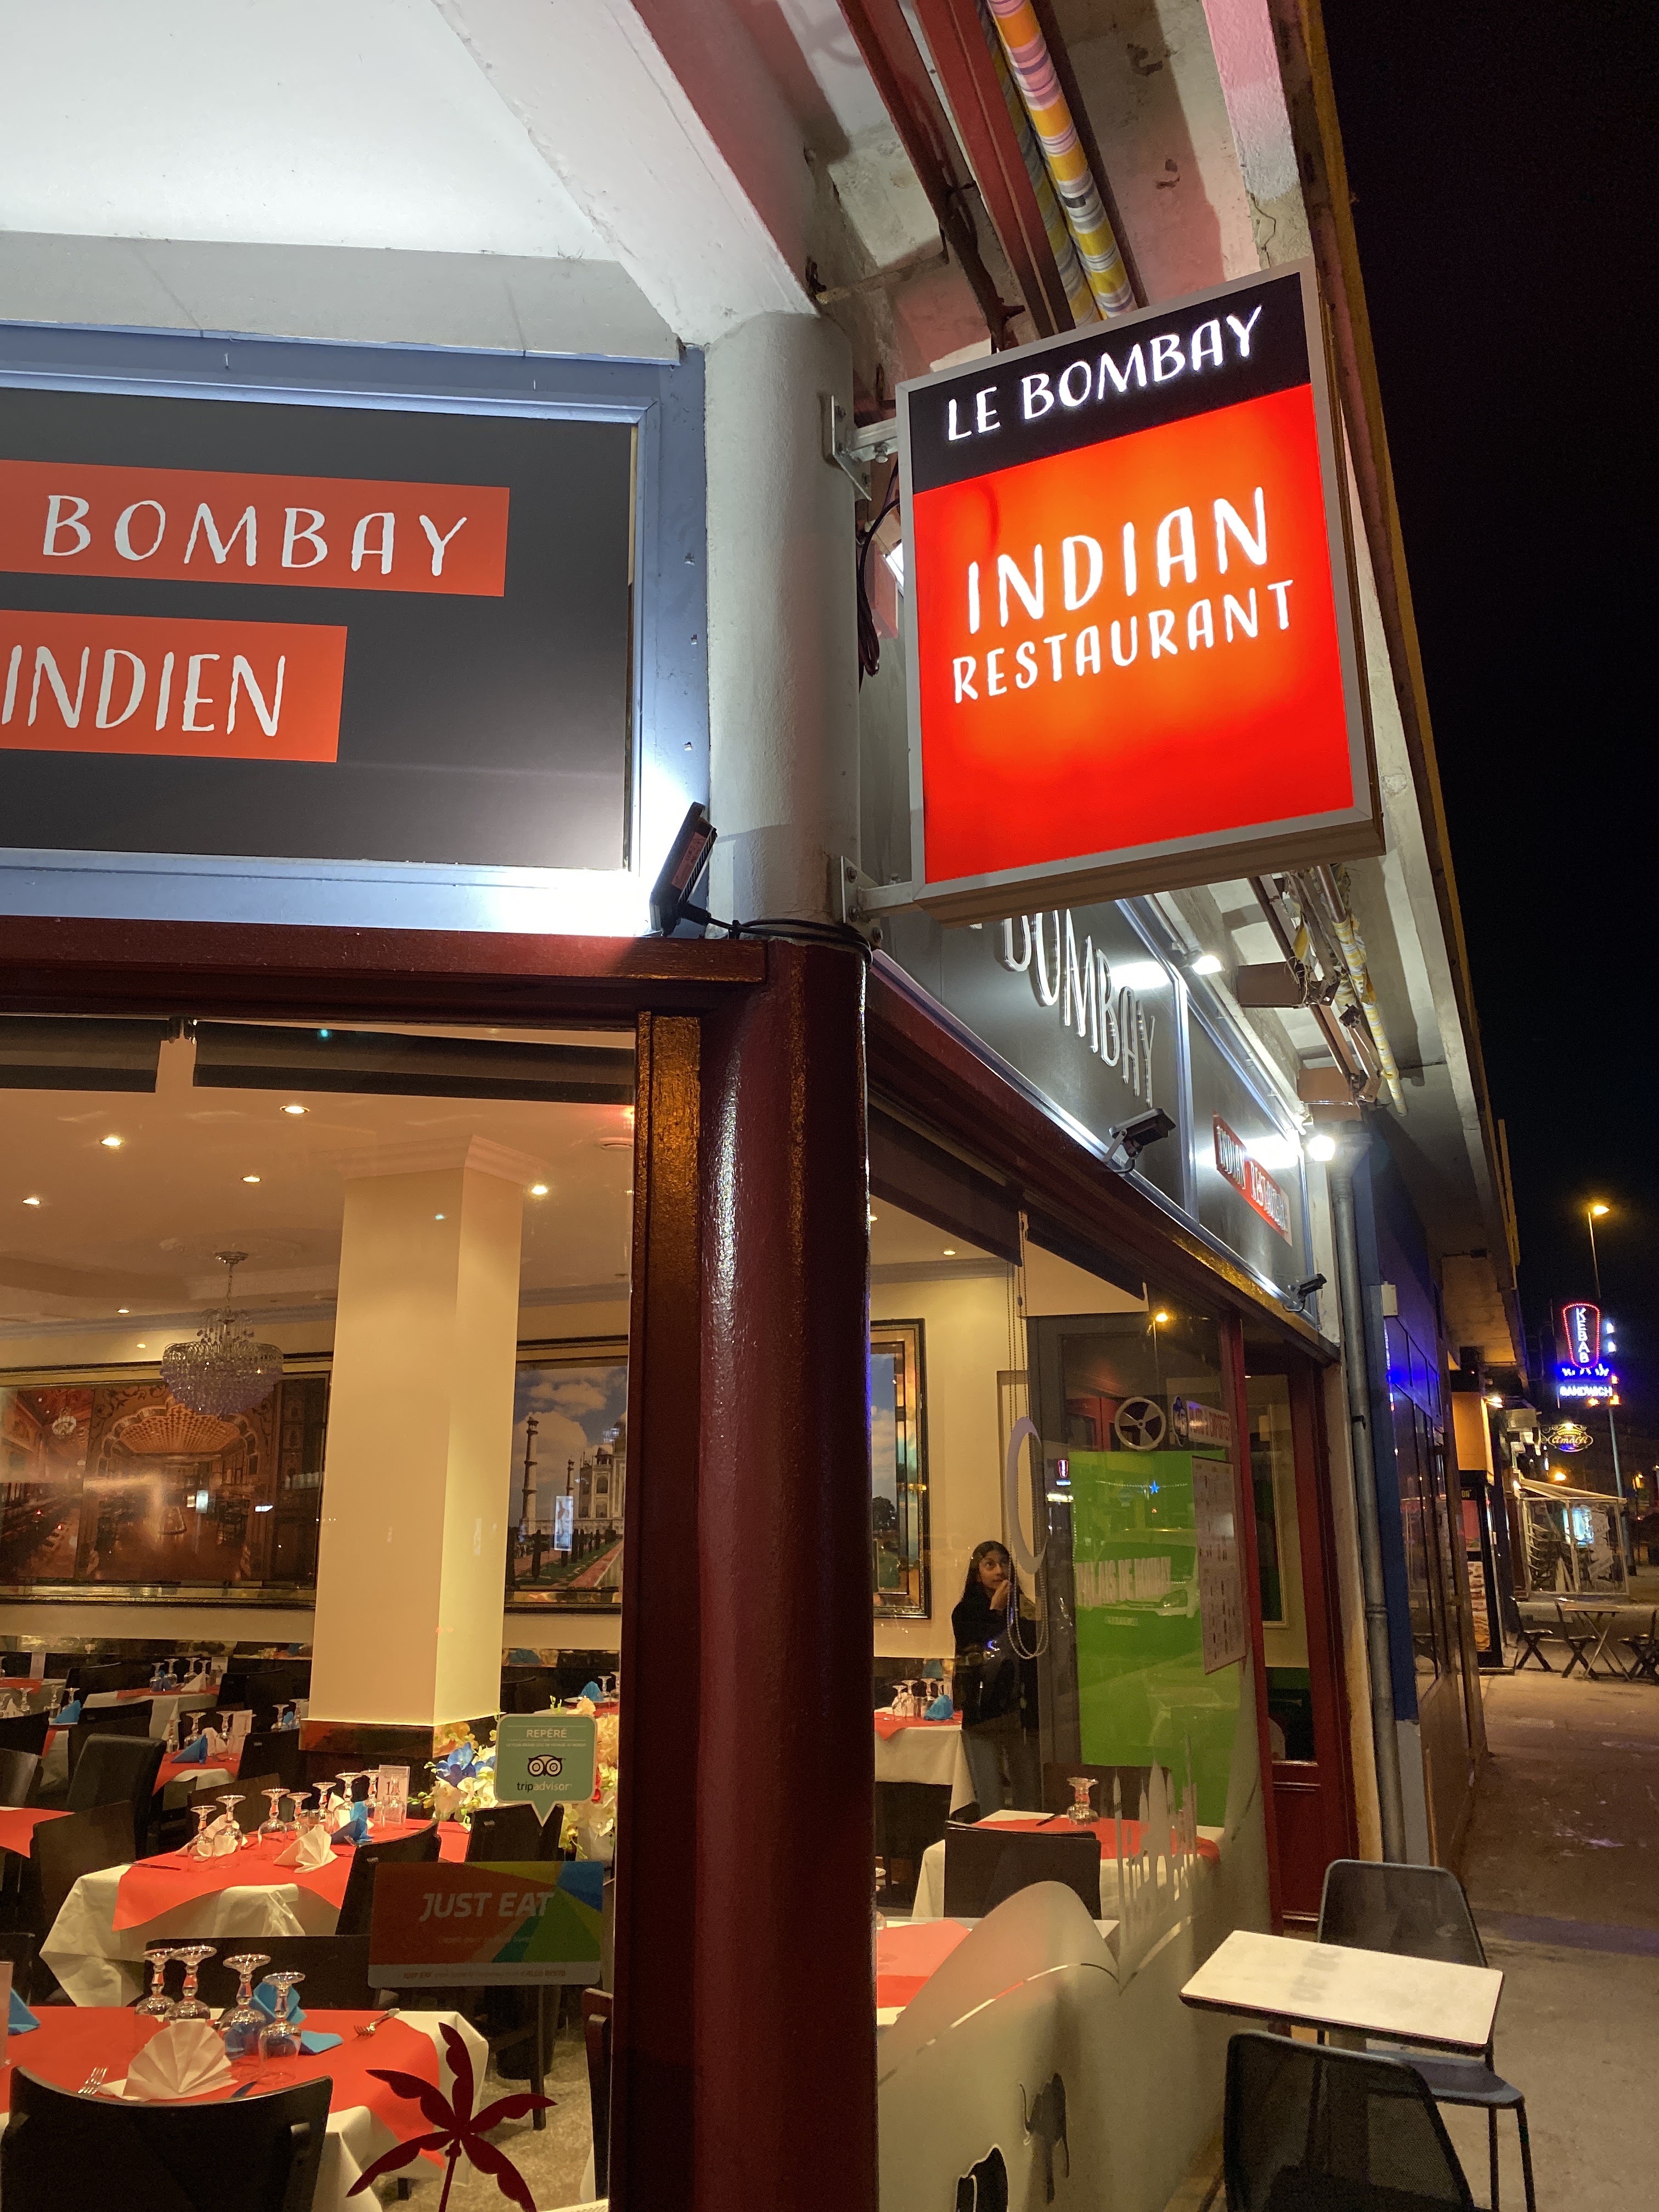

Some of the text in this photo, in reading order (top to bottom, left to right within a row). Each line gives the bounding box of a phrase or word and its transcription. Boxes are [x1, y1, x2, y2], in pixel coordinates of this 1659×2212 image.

[947, 304, 1263, 442] LE BOMBAY
[42, 494, 468, 577] BOMBAY
[967, 486, 1269, 634] INDIAN
[952, 579, 1294, 704] RESTAURANT
[1, 645, 286, 737] INDIEN
[1576, 1307, 1591, 1364] KEBAB
[1559, 1385, 1613, 1397] SANDWICH
[526, 1728, 568, 1739] REPÉRÉ
[516, 1781, 571, 1793] tripadvisor
[419, 1891, 555, 1922] JUST EAT
